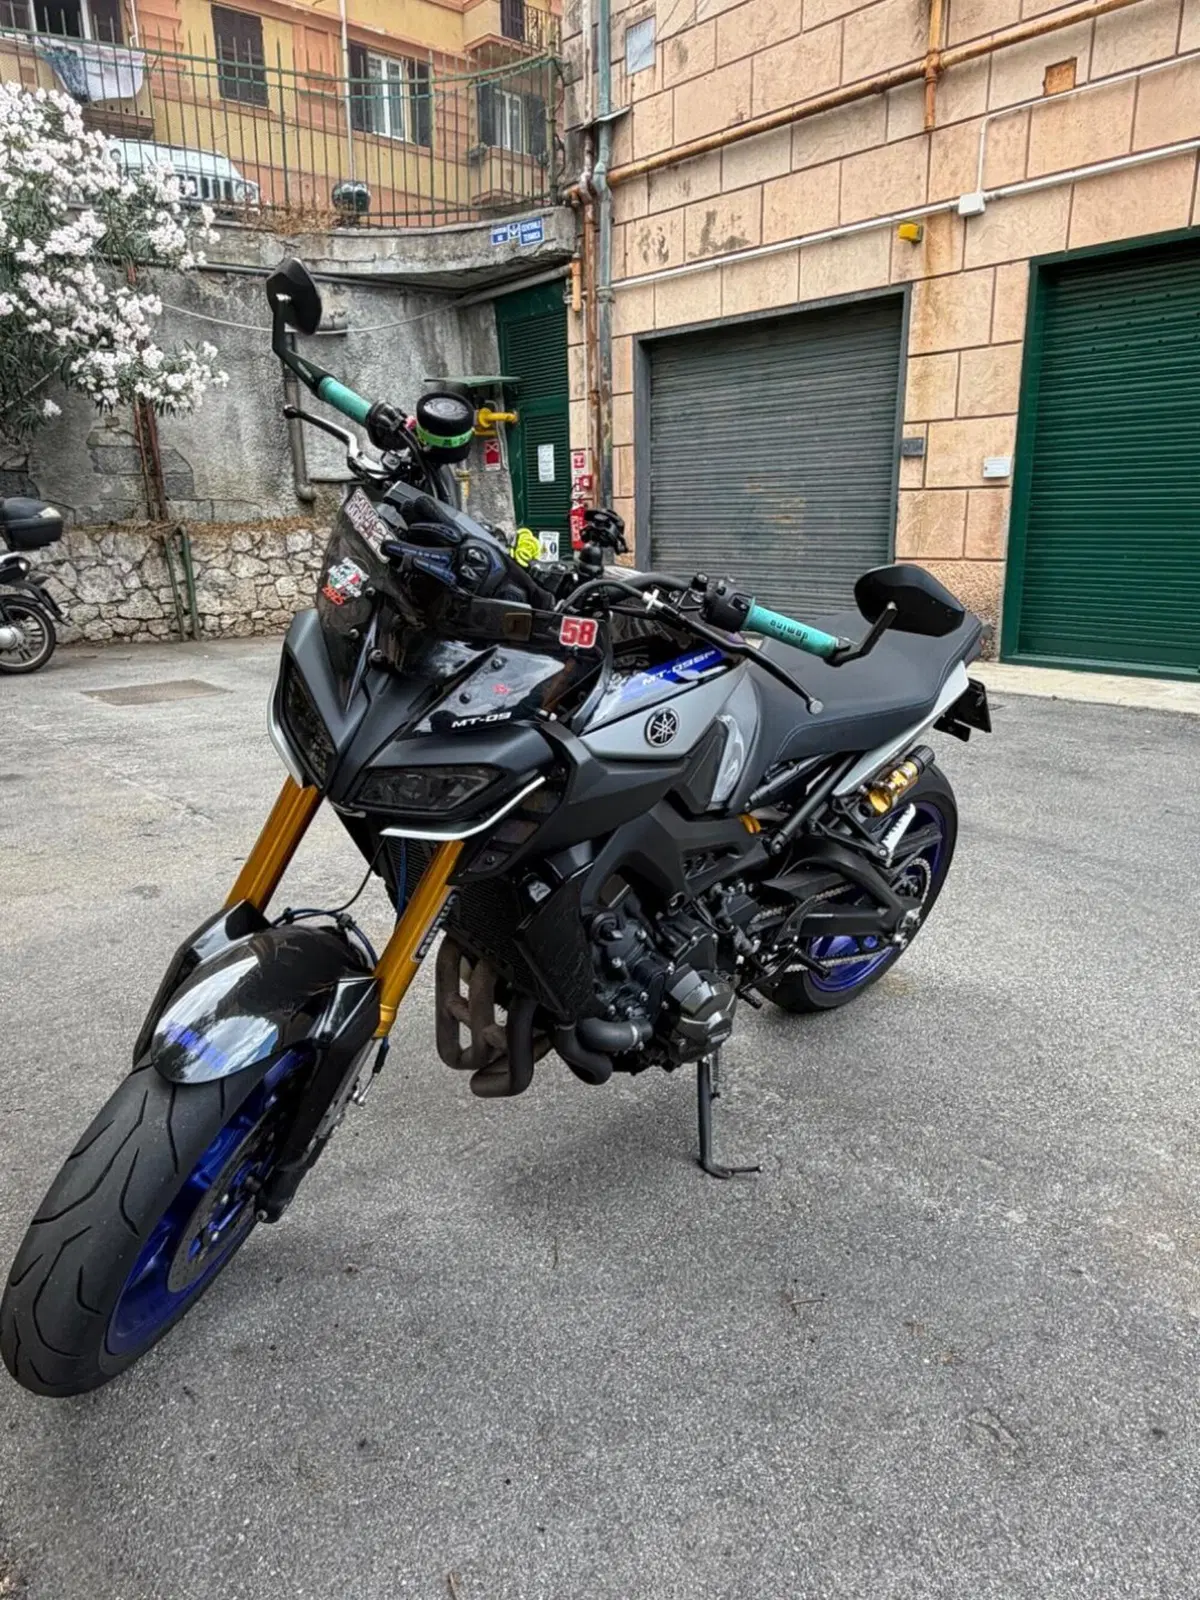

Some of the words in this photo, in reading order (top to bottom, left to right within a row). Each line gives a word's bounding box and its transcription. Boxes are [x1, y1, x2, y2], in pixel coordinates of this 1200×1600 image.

[559, 616, 598, 648] 58
[770, 620, 809, 645] domino
[451, 711, 512, 728] MT-09
